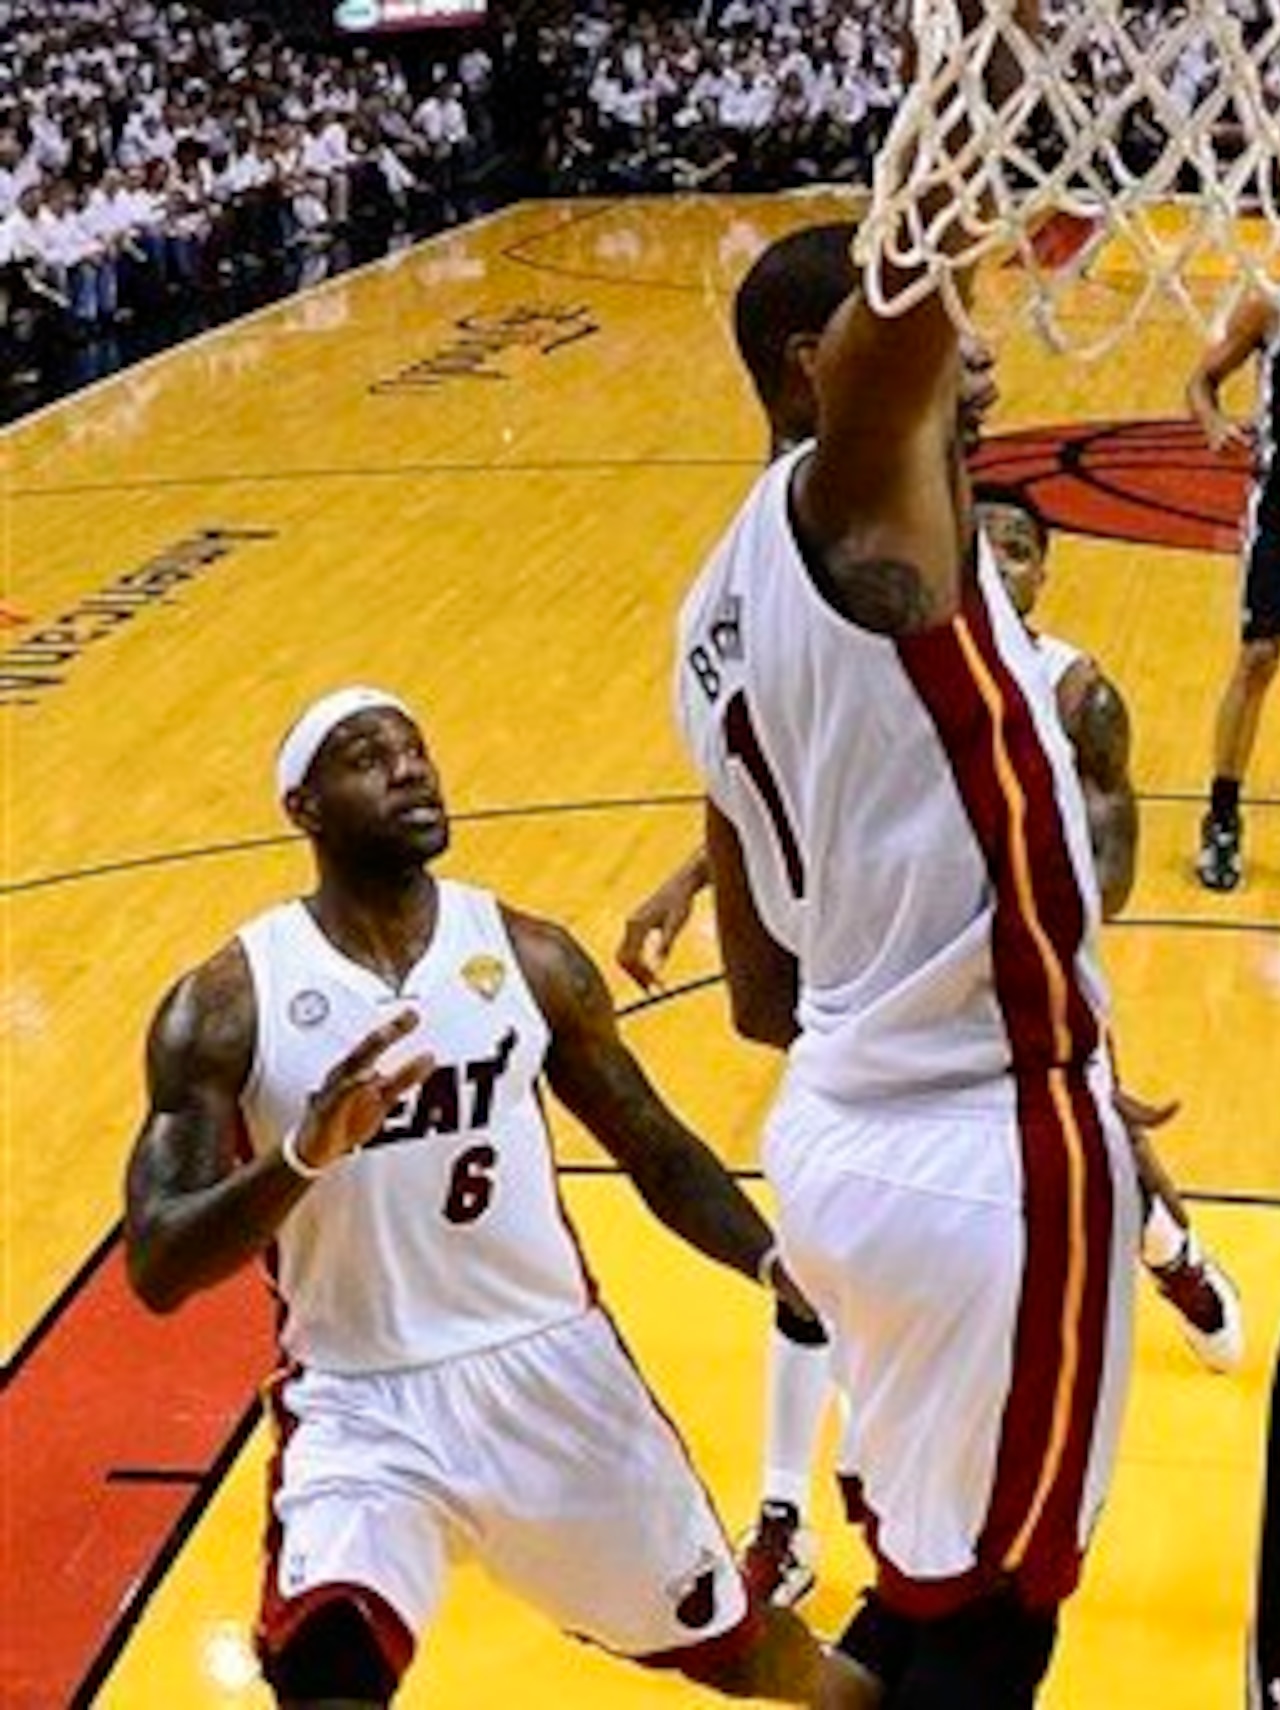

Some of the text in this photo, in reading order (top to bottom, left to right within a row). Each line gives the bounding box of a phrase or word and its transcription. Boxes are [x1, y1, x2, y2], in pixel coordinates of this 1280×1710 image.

[725, 688, 805, 899] 1
[364, 1027, 518, 1150] EAT
[442, 1145, 497, 1224] 6
